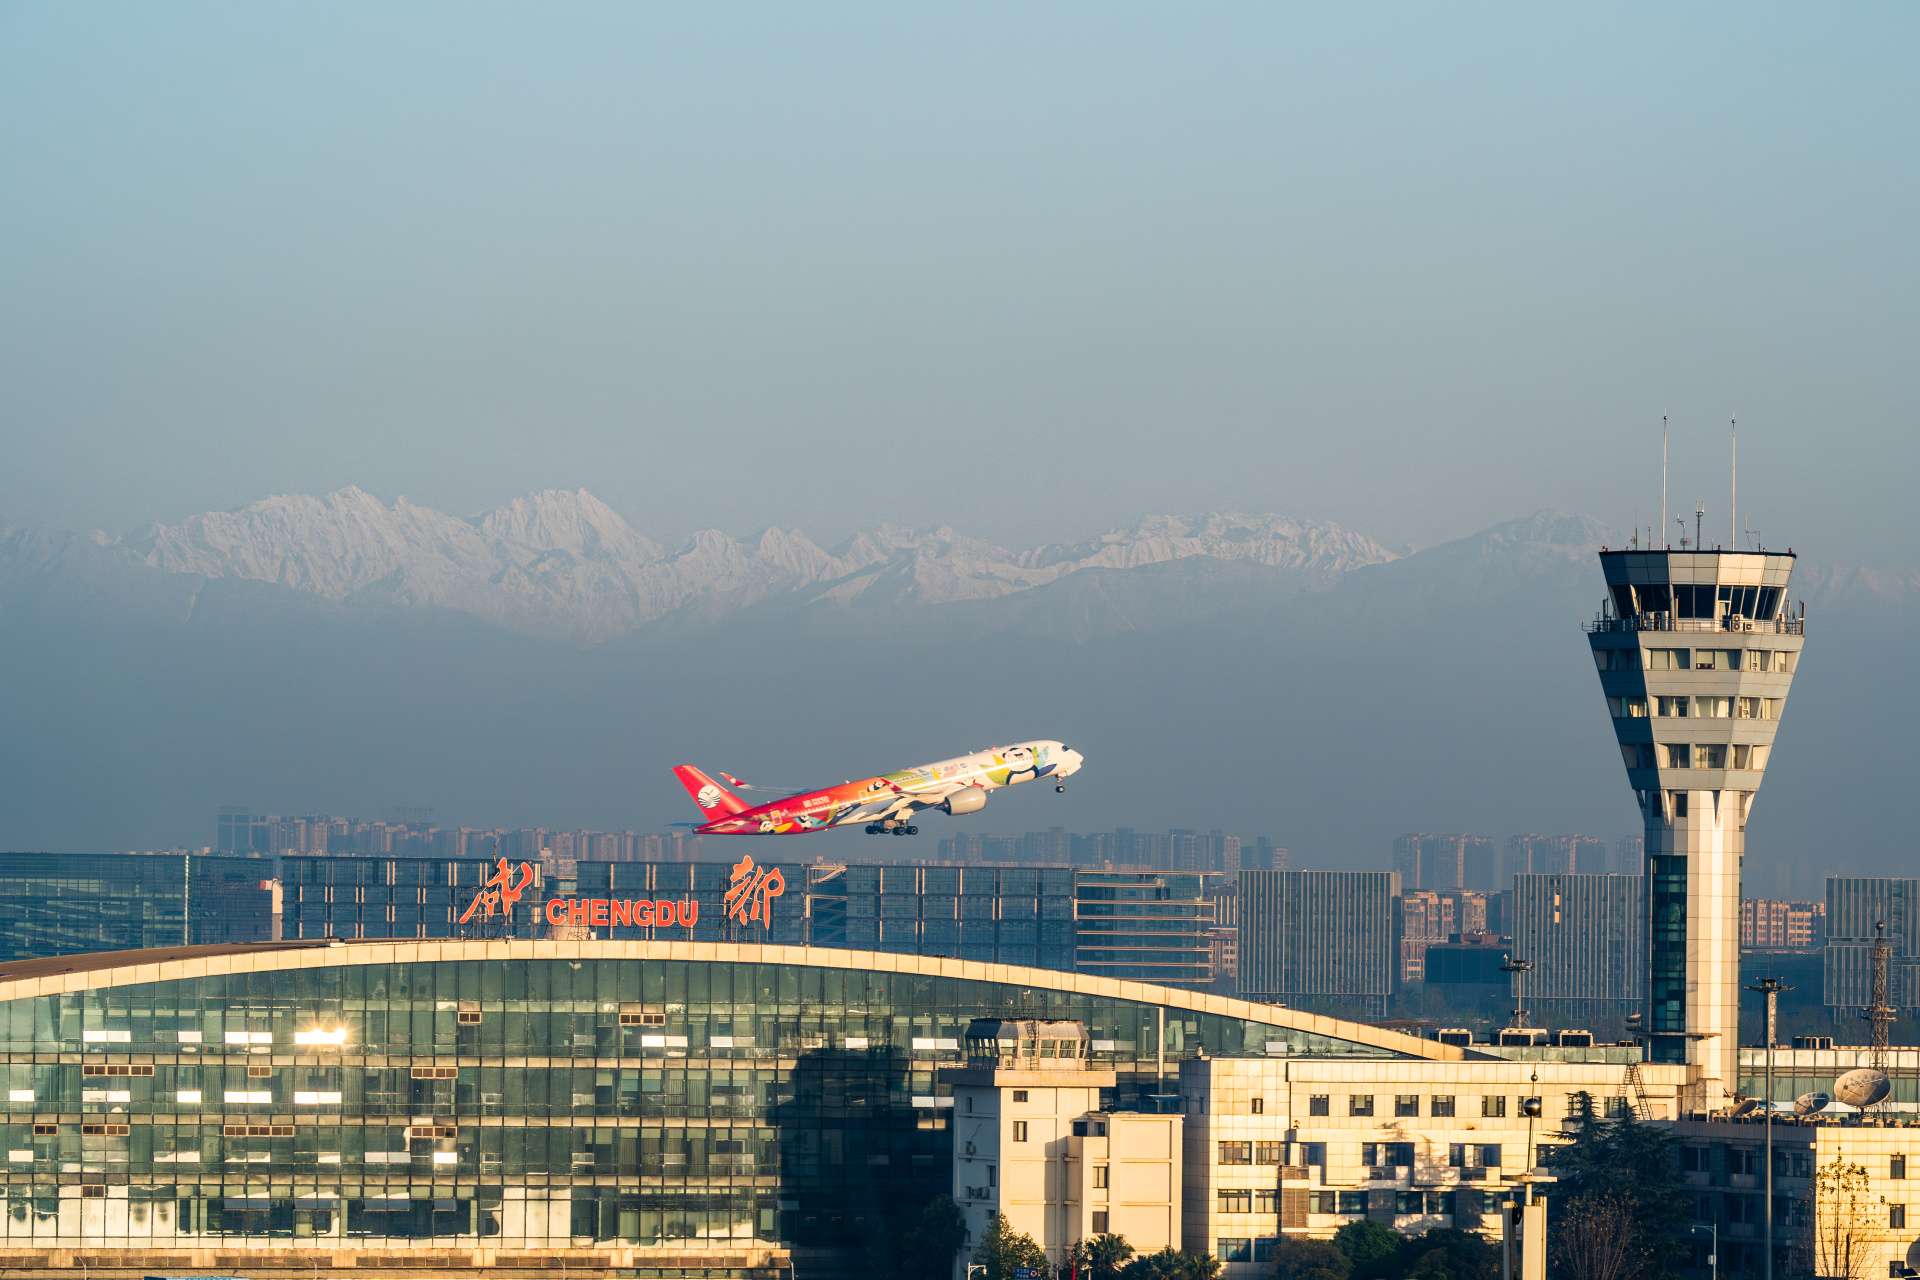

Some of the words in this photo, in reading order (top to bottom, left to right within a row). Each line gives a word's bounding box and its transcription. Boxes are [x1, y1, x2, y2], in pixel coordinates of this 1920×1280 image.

[459, 856, 534, 925] 成
[546, 898, 699, 927] CHENGDU
[725, 854, 786, 931] 都
